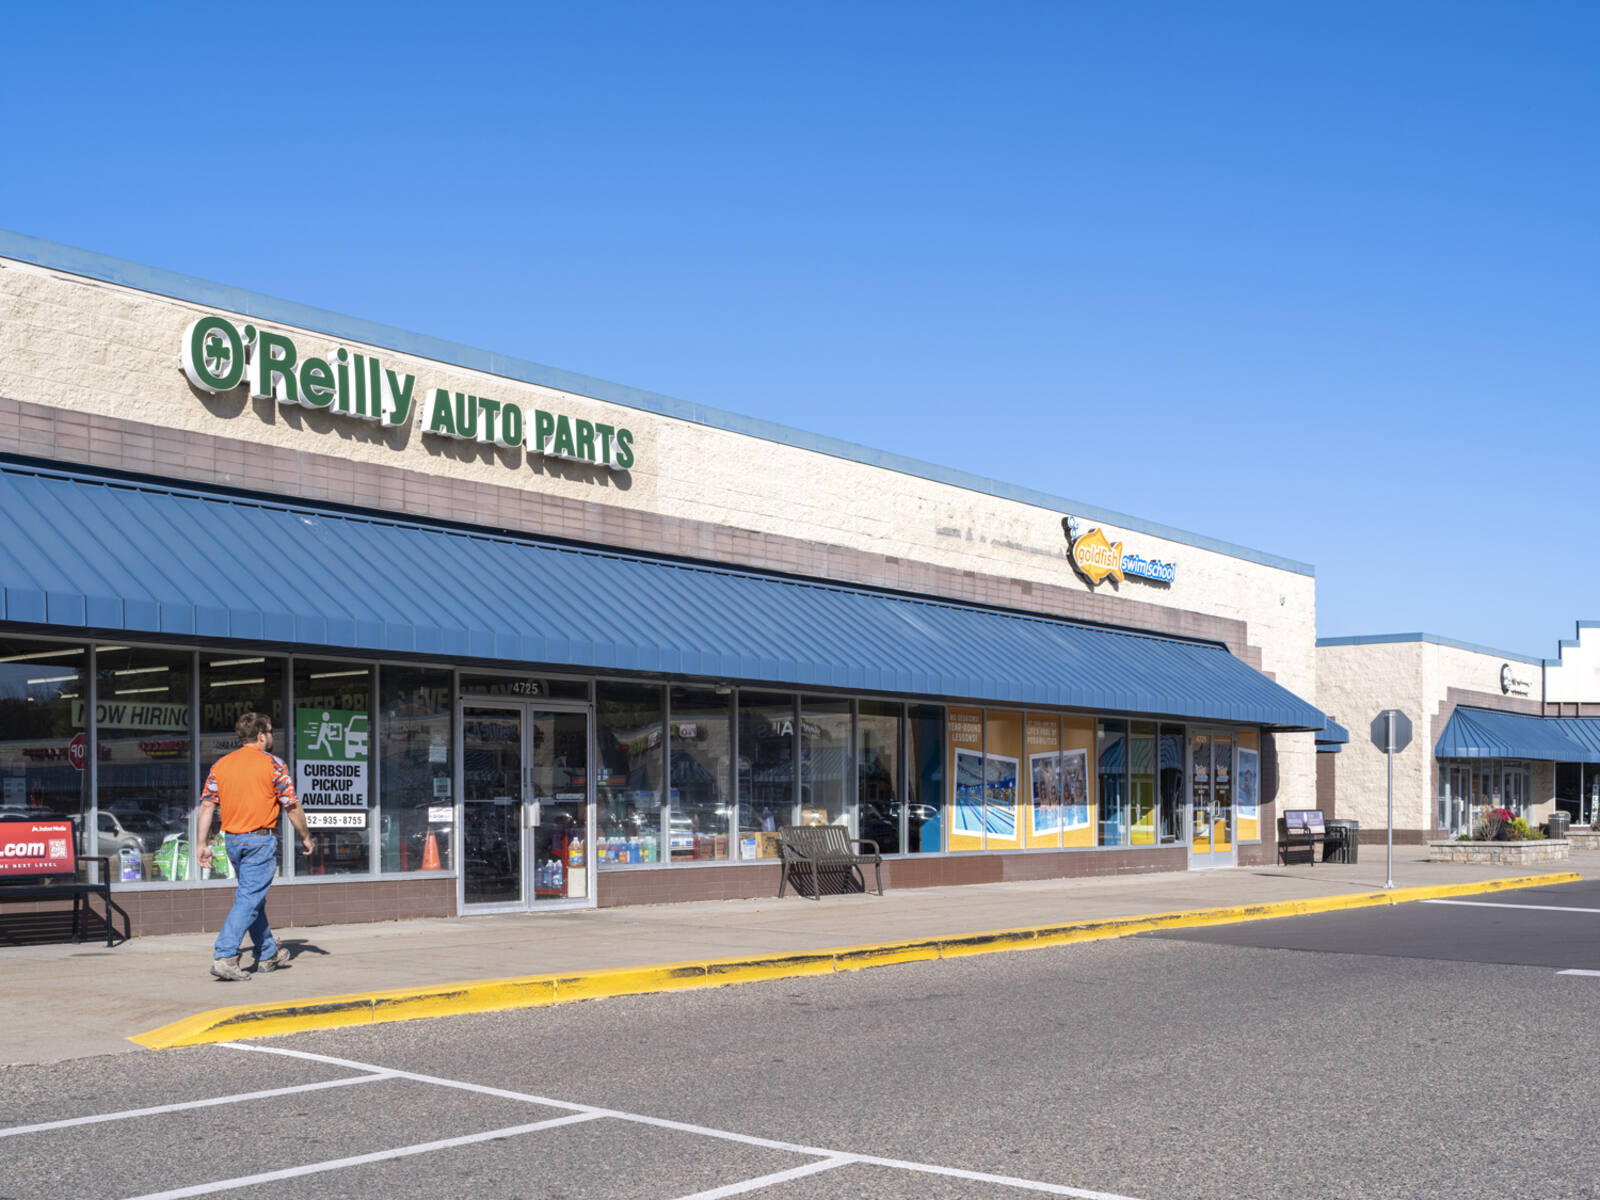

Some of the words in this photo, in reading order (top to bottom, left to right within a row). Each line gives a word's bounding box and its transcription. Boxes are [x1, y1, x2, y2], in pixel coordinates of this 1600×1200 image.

[182, 316, 416, 427] O'Reilly
[421, 388, 522, 448] AUTO
[527, 409, 635, 471] PARTS
[1077, 544, 1119, 571] goldfish
[1121, 554, 1147, 577] swim
[1147, 560, 1176, 582] school
[513, 682, 539, 695] 4725
[304, 764, 361, 777] CURBSIDE
[312, 779, 353, 791] PICKUP
[302, 793, 363, 806] AVAILABLE
[304, 816, 362, 825] 52-935-8755
